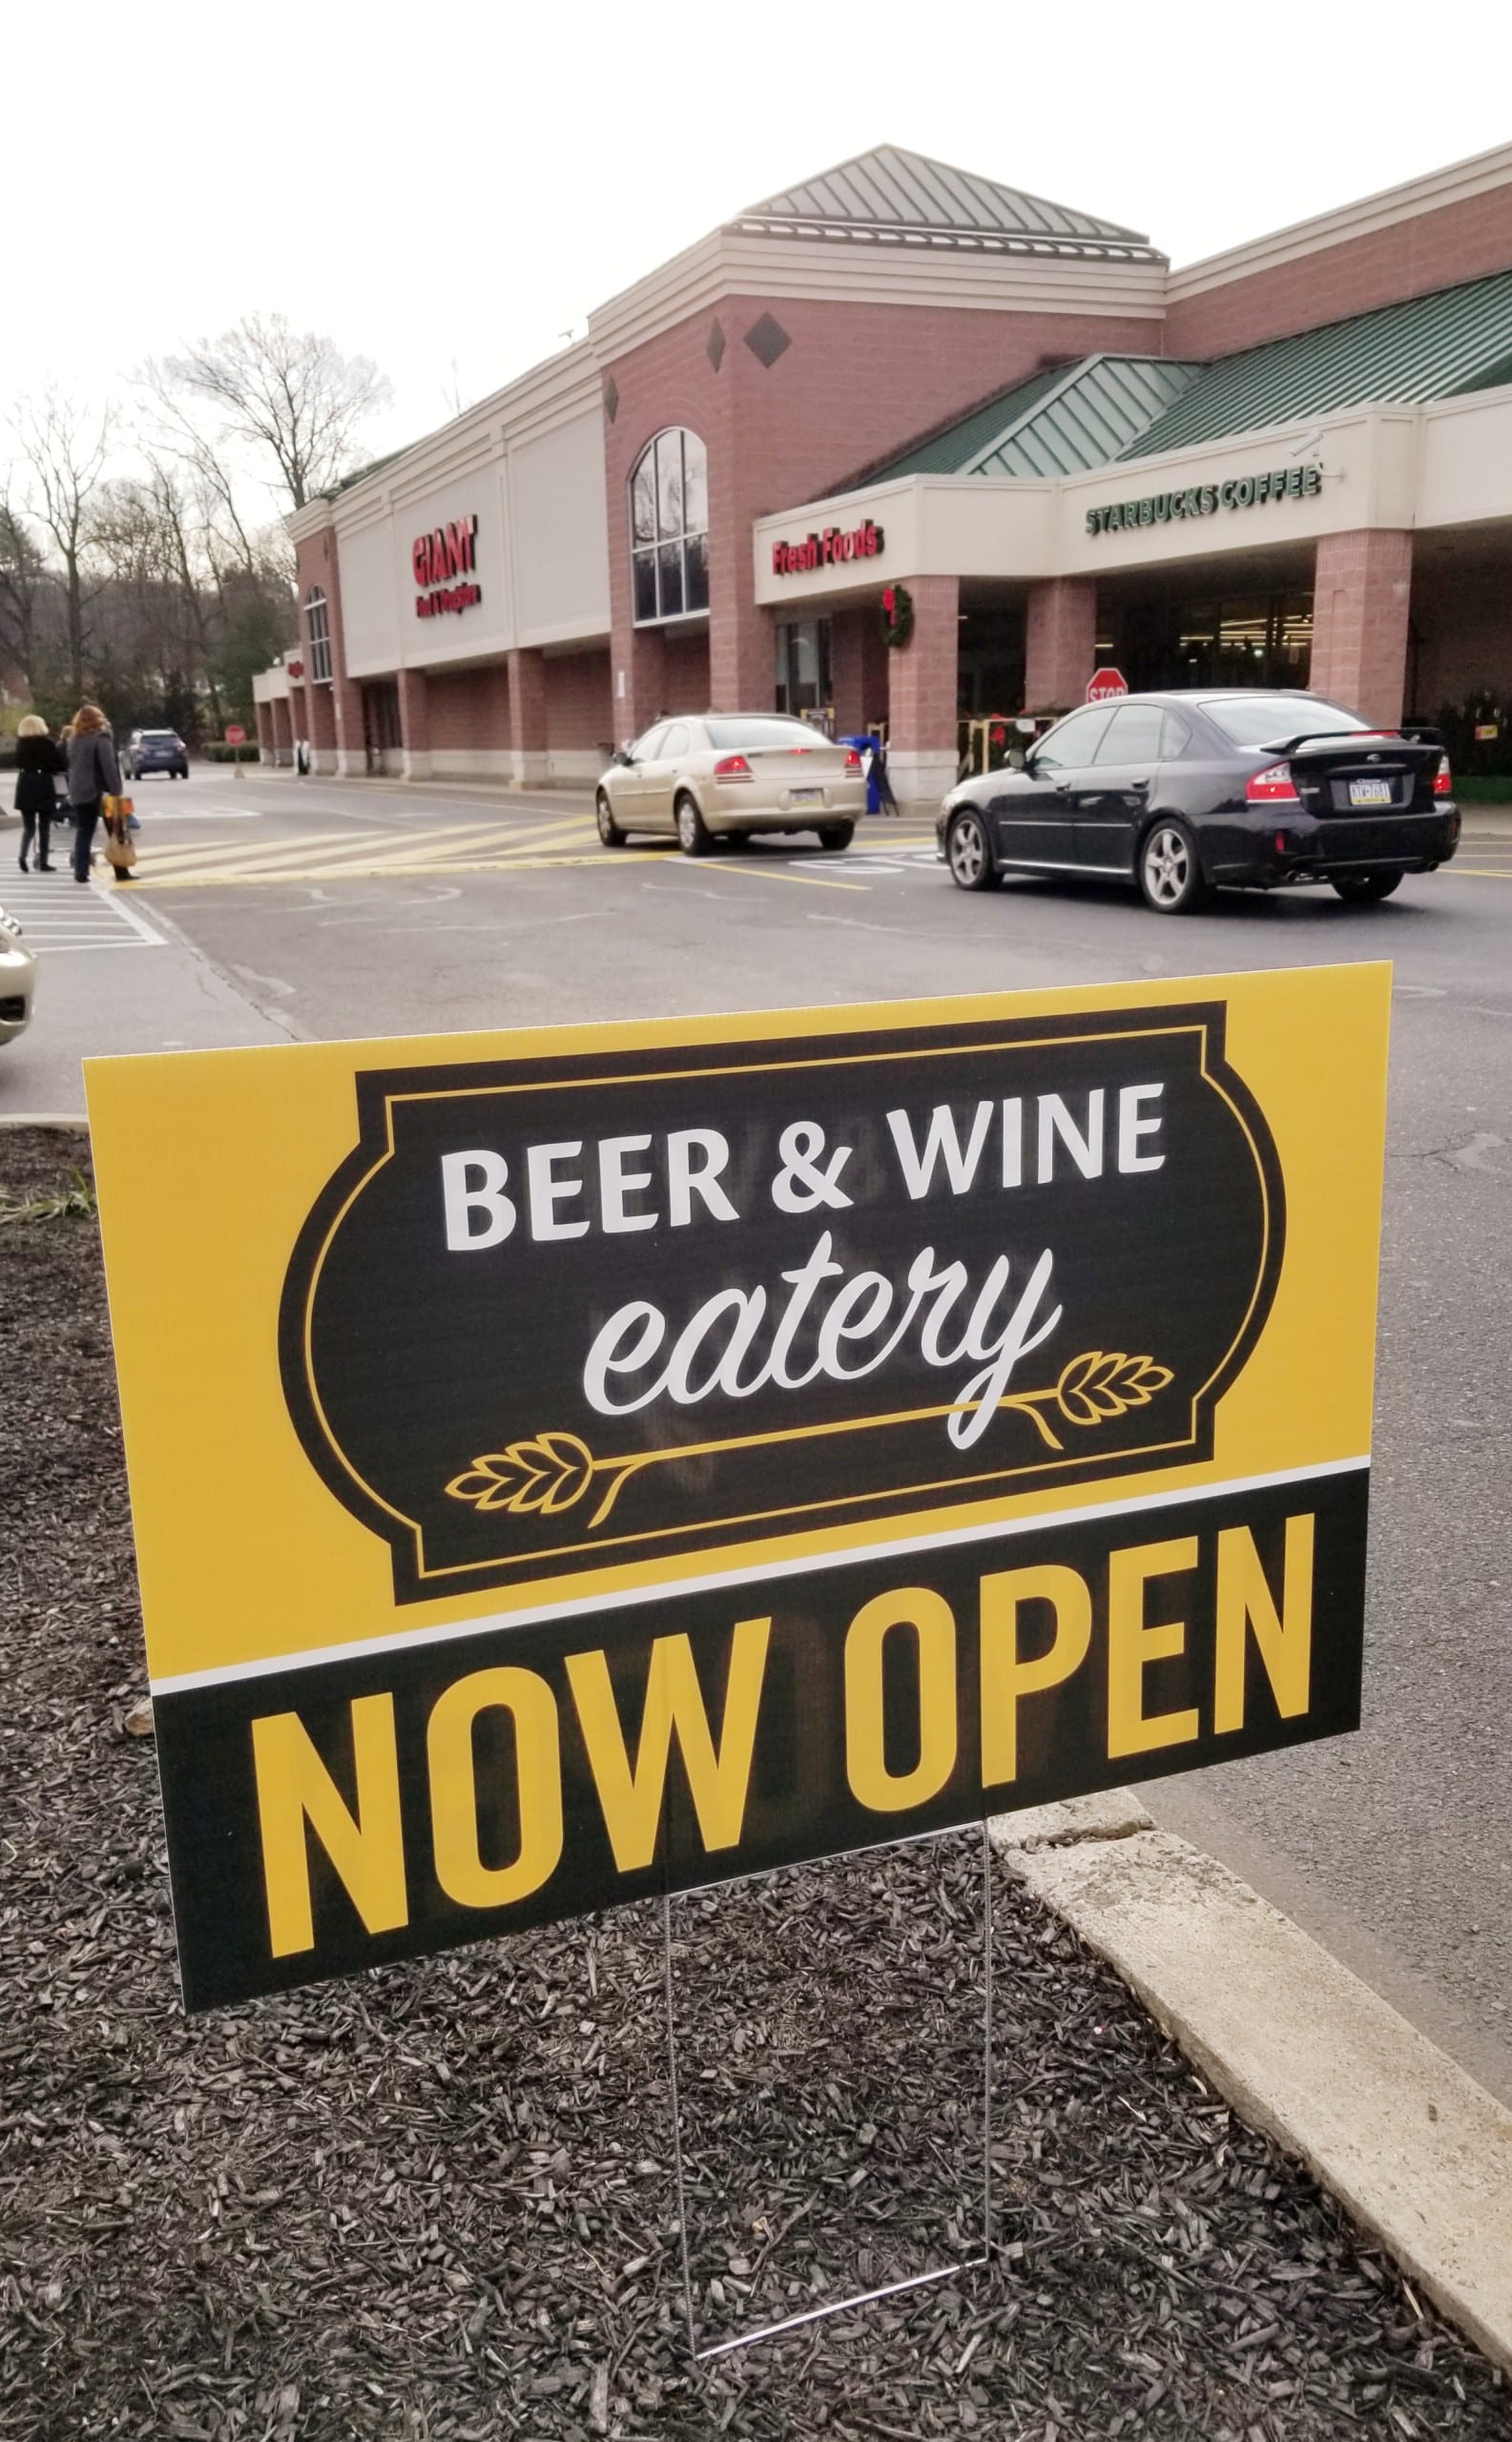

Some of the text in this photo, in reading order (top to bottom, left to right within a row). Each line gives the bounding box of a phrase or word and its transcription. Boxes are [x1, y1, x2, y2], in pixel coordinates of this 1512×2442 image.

[413, 514, 478, 587] GIANT
[772, 519, 884, 575] Fresh Foods
[1086, 465, 1322, 535] STARBUCKS COFFEE
[442, 1084, 1166, 1251] BEER & WINE
[584, 1231, 1062, 1450] eatery
[252, 1514, 1315, 1957] NOW OPEN
